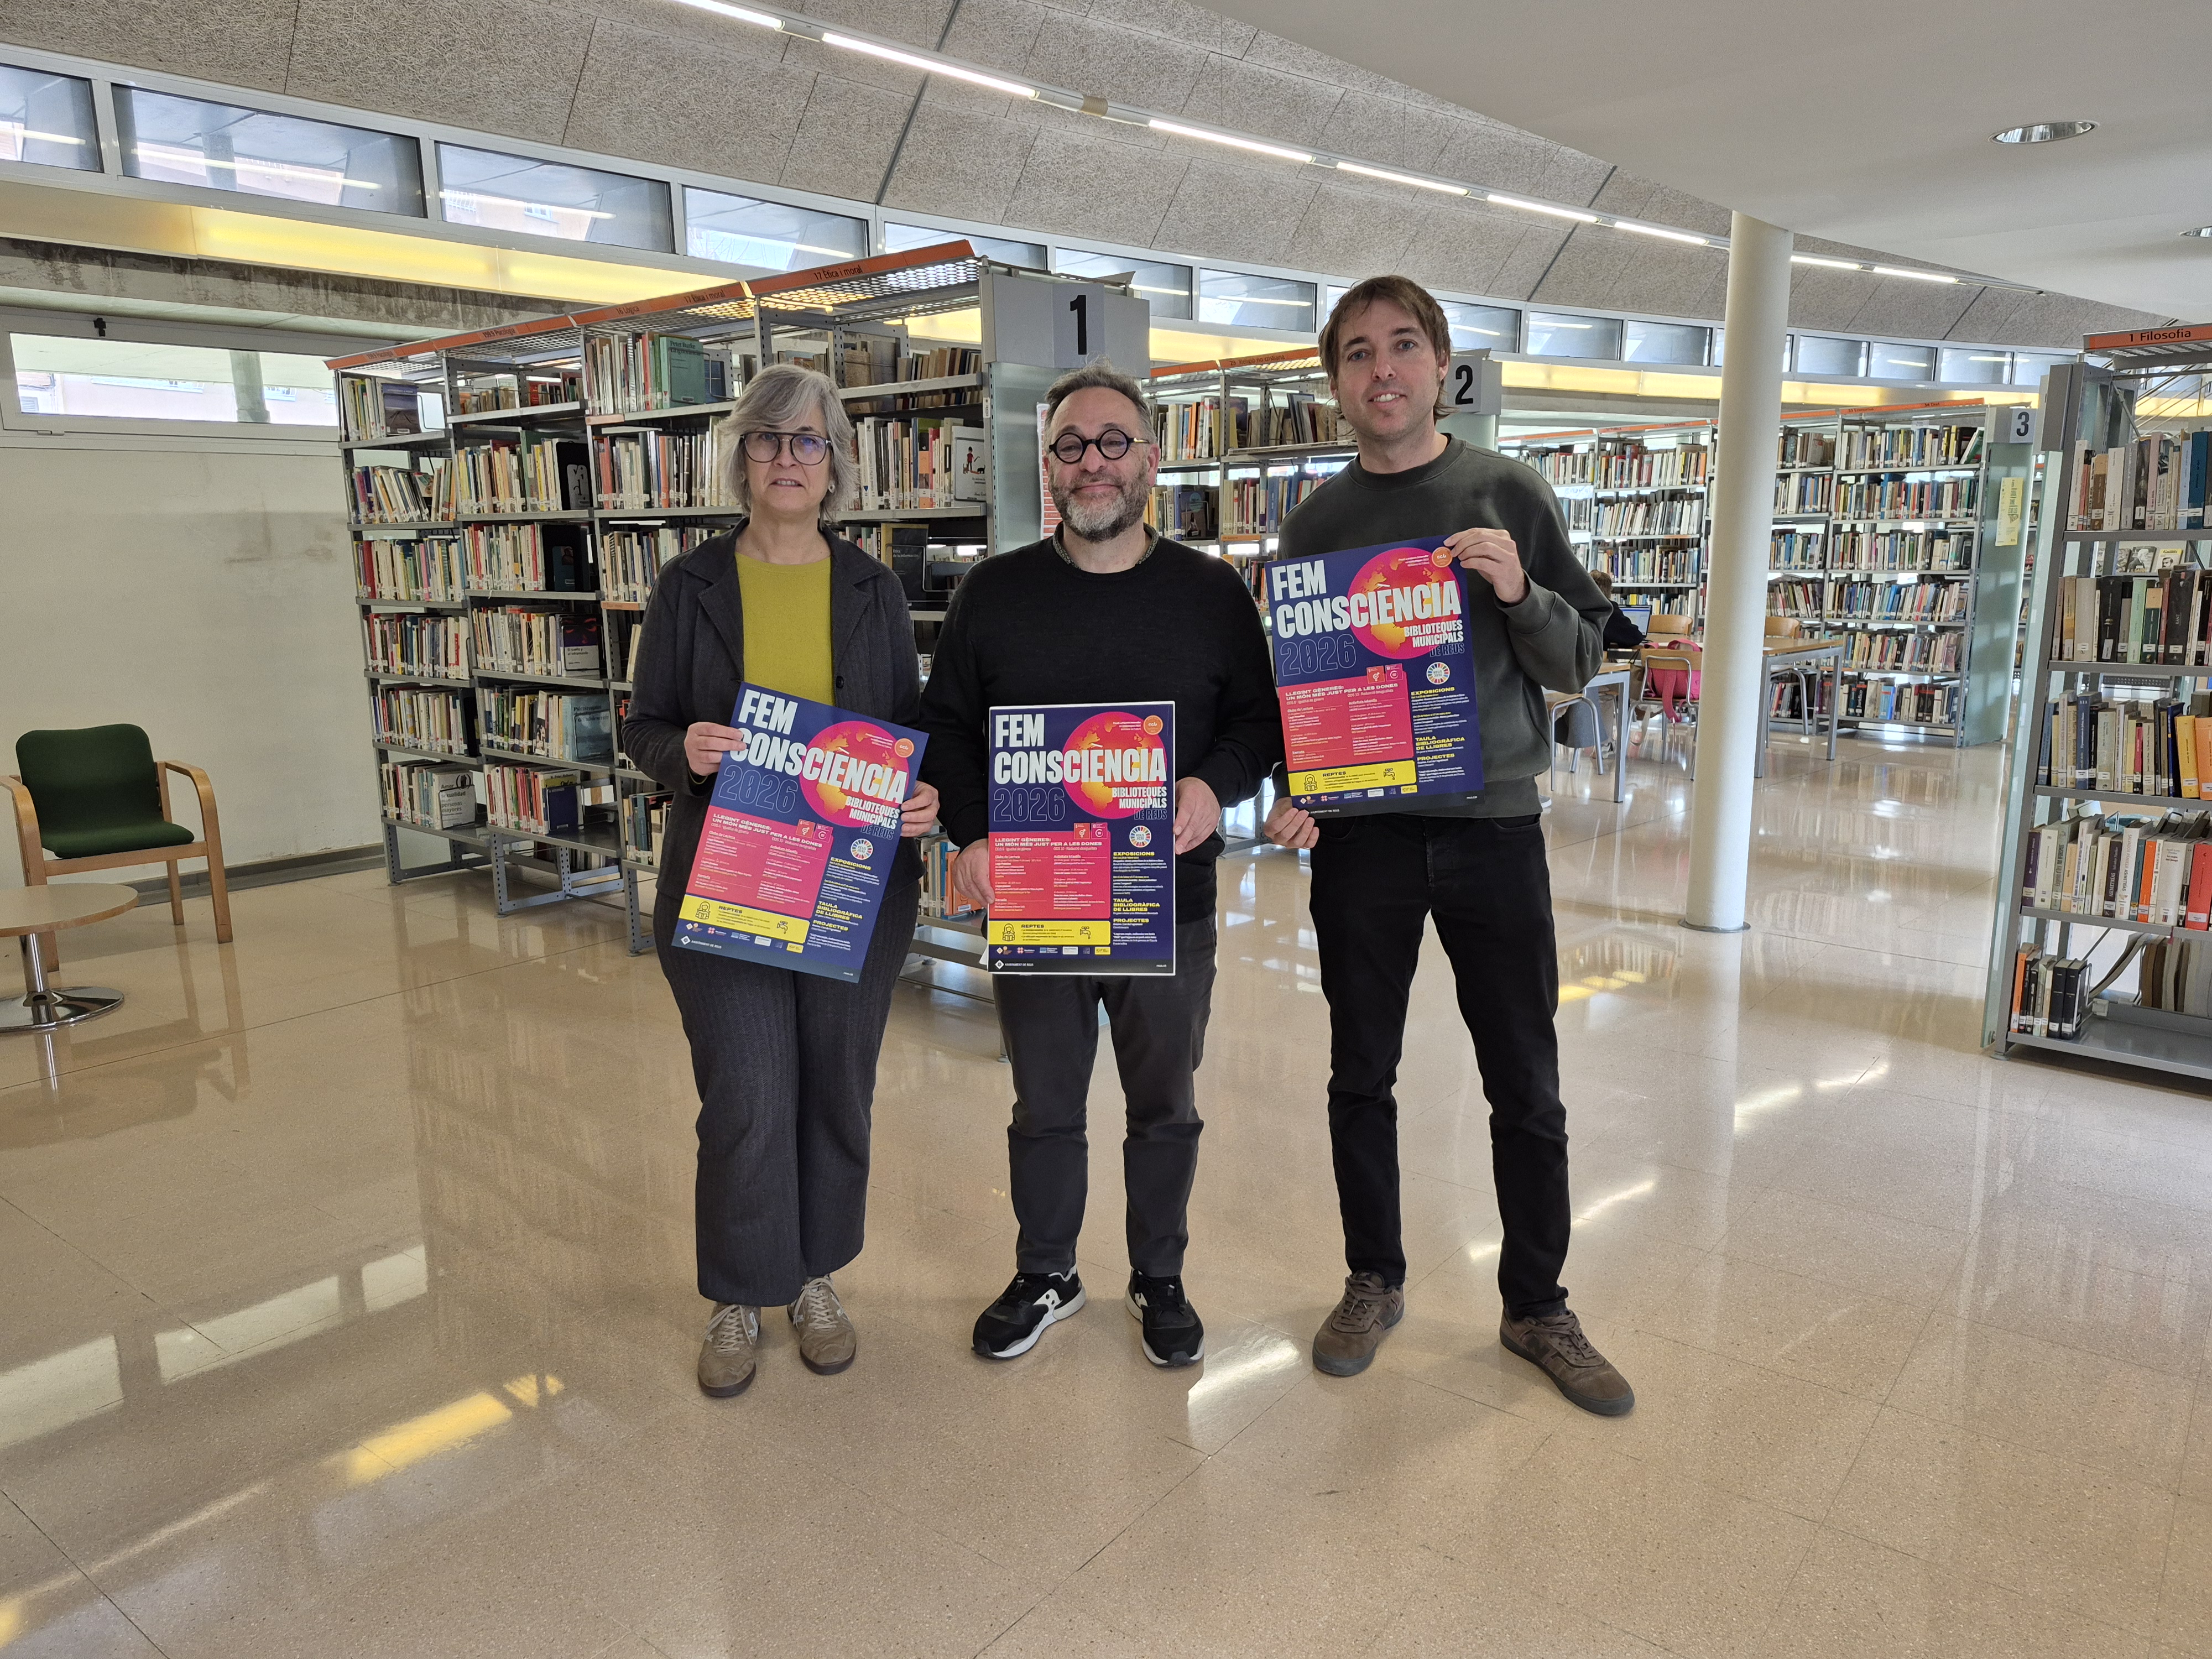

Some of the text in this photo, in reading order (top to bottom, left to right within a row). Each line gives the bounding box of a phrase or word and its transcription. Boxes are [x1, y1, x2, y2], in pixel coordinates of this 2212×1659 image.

[815, 264, 863, 281] 17 Ètica i moral
[684, 295, 691, 304] 17
[708, 289, 726, 299] moral
[1070, 295, 1086, 355] 1
[2128, 328, 2192, 342] 1 Filosofia
[1455, 365, 1474, 405] 2
[2016, 411, 2030, 436] 3
[1272, 560, 1327, 602] FEM
[1276, 580, 1462, 638] CONSCIÈNCIA
[1404, 619, 1463, 637] BIBLIOTEQUES
[1412, 630, 1464, 648] MUNICIPALS
[1280, 633, 1357, 677] 2026
[1429, 642, 1464, 658] DE REUS
[1411, 686, 1455, 696] EXPOSICIONS
[738, 689, 798, 735] FEM
[995, 713, 1044, 747] FEM
[1416, 737, 1465, 747] BIBLIOGRÀFICA
[730, 727, 909, 804] CONSCIÈNCIA
[995, 740, 1166, 785] CONSCIÈNCIA
[718, 764, 798, 813] 2026
[1112, 786, 1167, 800] BIBLIOTEQUES
[846, 796, 900, 819] BIBLIOTEQUES
[994, 787, 1065, 822] 2026
[1119, 798, 1167, 809] MUNICIPALS
[713, 813, 740, 823] LLEGINT
[849, 808, 897, 830] MUNICIPALS
[1134, 809, 1167, 820] DE REUS
[722, 819, 738, 827] MÓN
[738, 822, 753, 831] MÉS
[753, 827, 770, 835] JUST
[801, 838, 822, 848] DONES
[860, 822, 894, 841] DE REUS
[830, 857, 872, 870] EXPOSICIONS
[2107, 872, 2116, 898] ASIMETRÍAS
[817, 905, 863, 920] BIBLIOGRÀFICA
[825, 911, 850, 920] LLIBRES
[812, 919, 849, 931] PROJECTES
